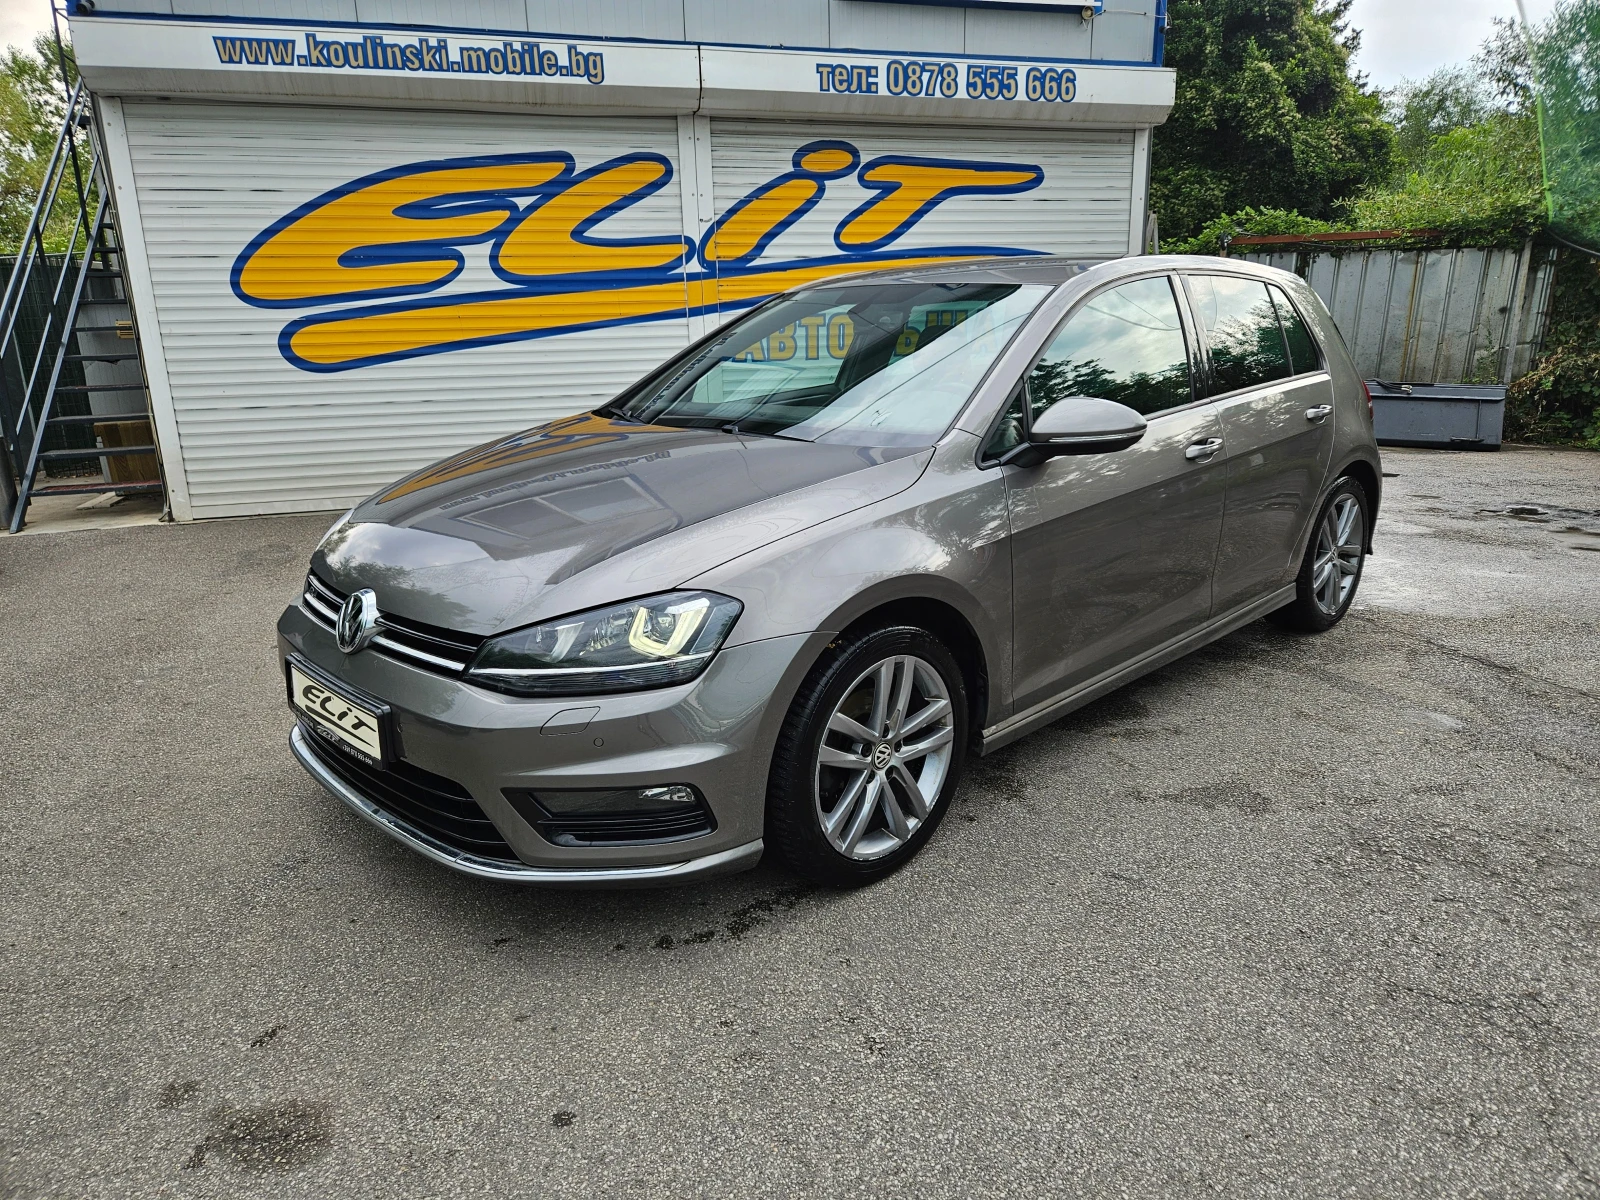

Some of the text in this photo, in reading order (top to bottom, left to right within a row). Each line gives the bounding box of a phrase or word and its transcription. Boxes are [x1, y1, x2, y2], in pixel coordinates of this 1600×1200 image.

[212, 33, 605, 84] www.koulinski.mobile.bg
[816, 60, 1076, 102] тел: 0878 555 666
